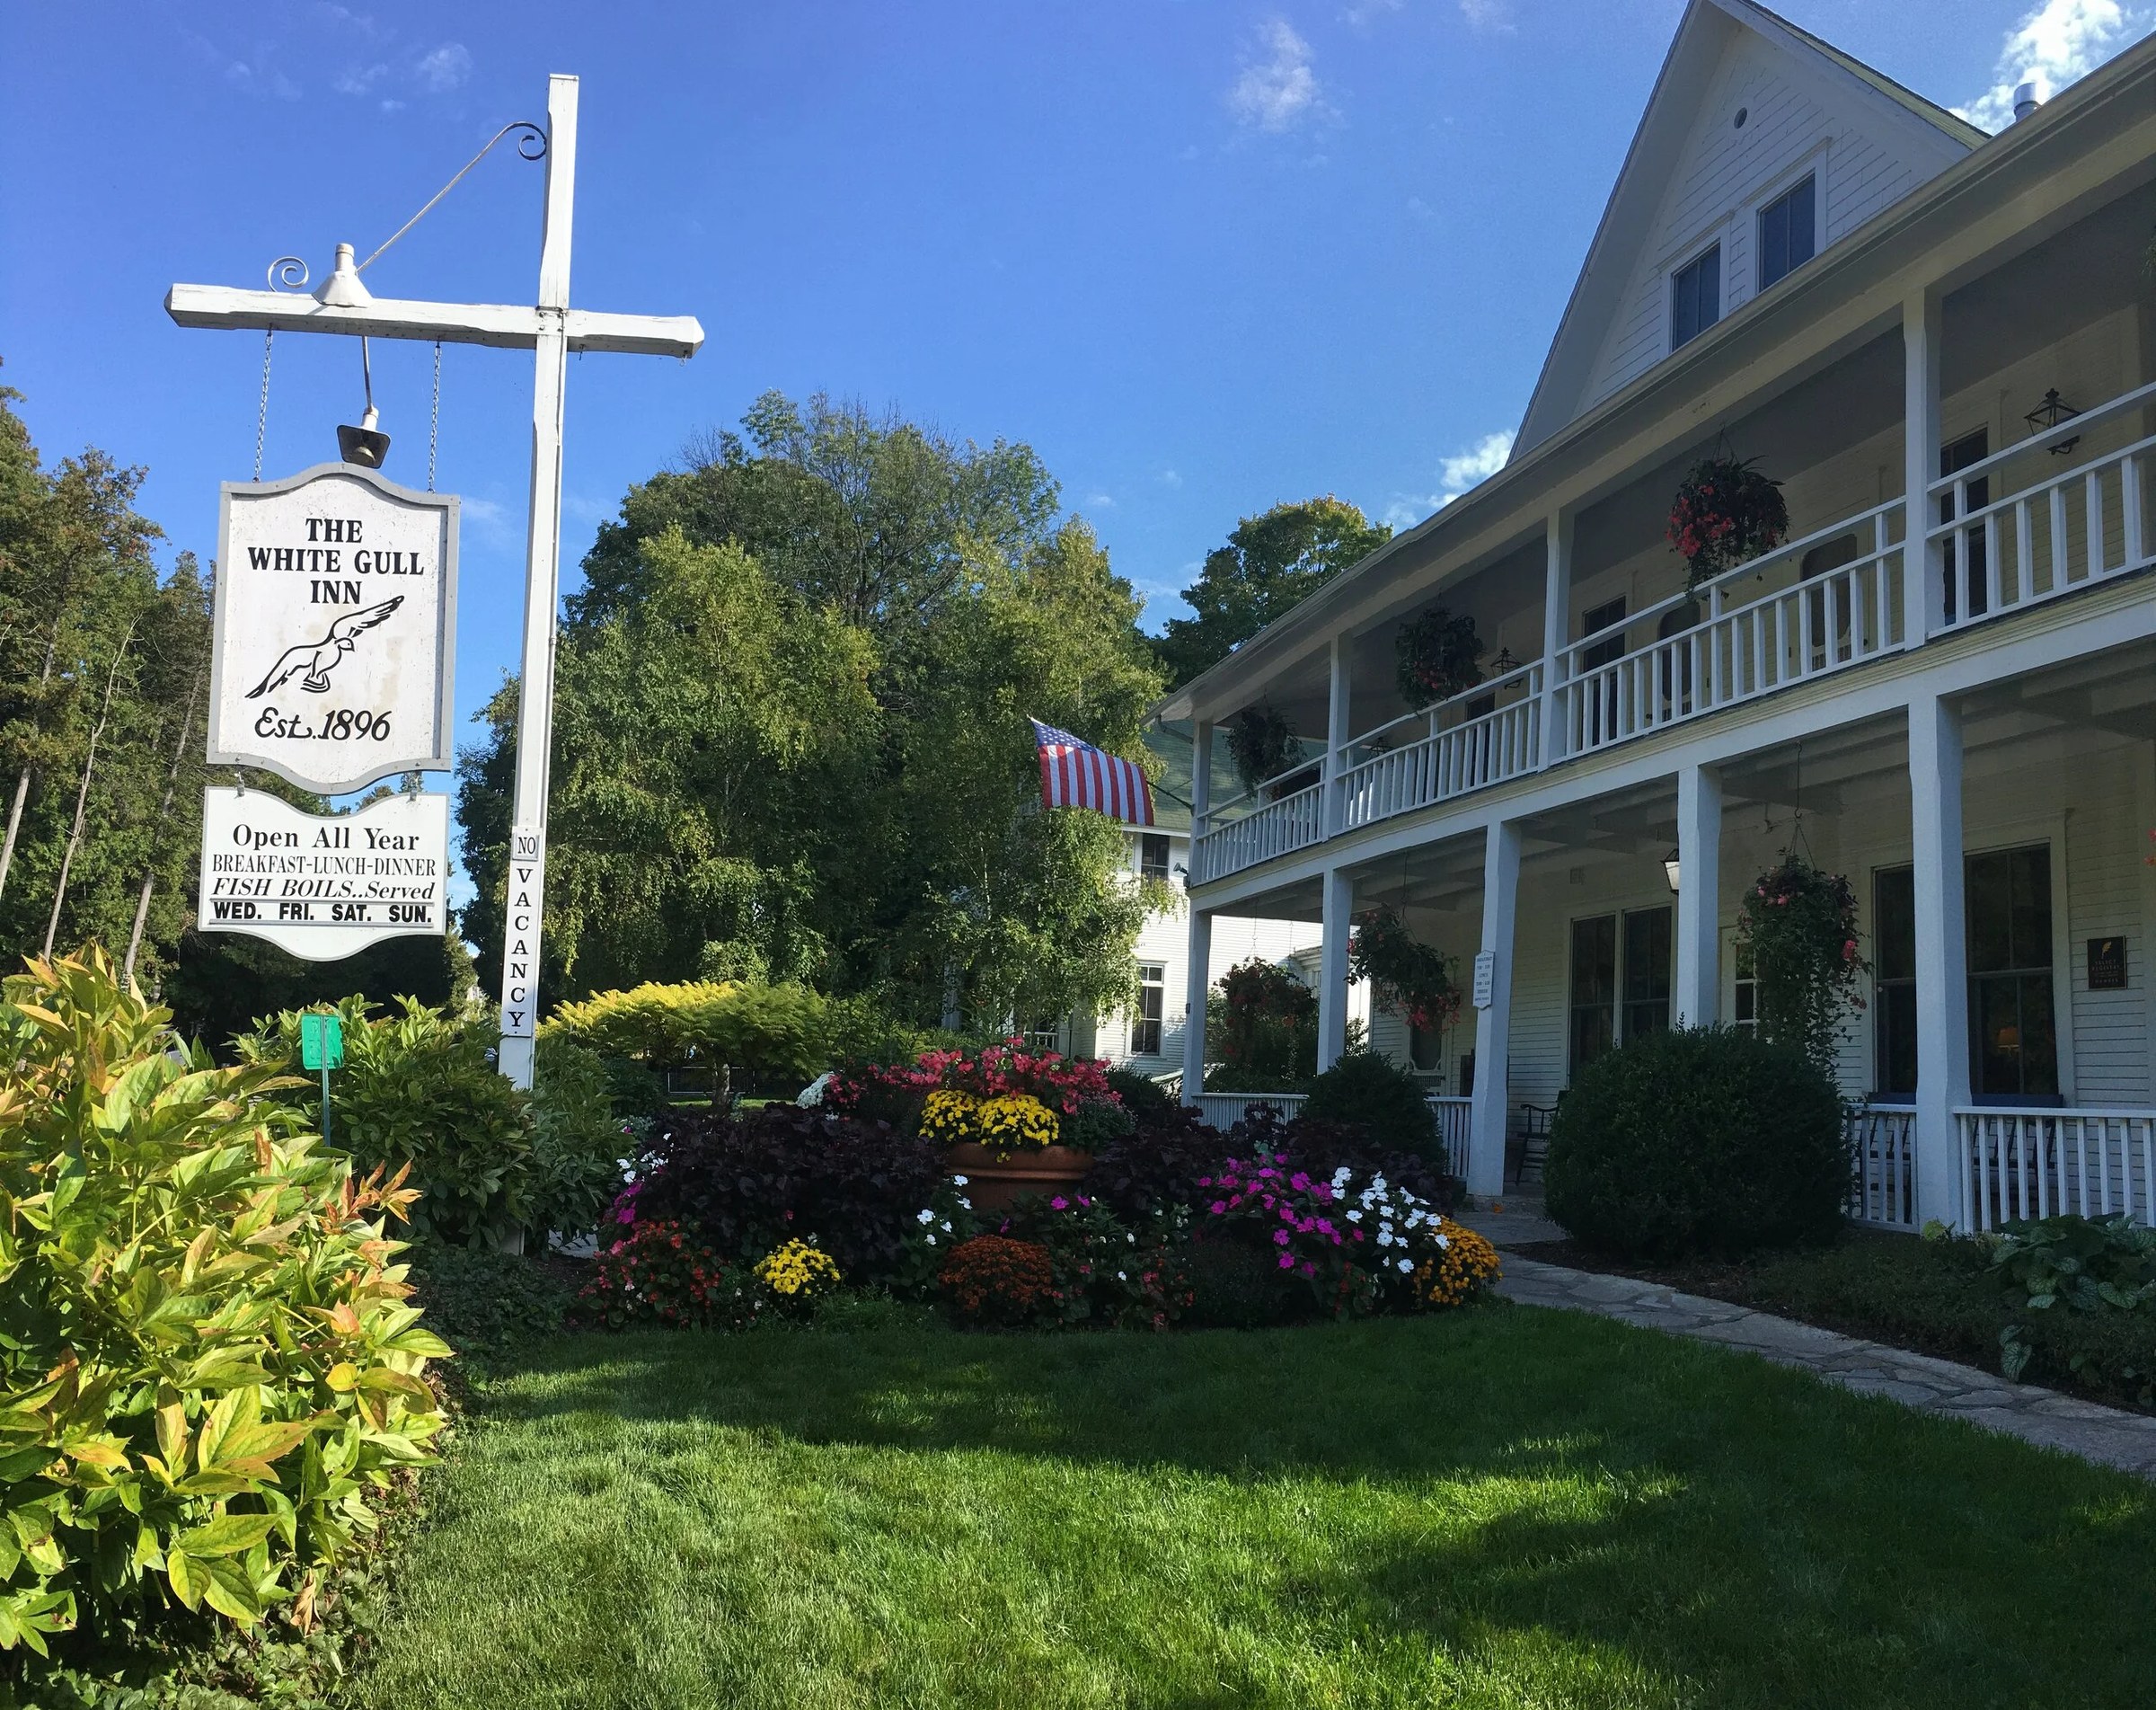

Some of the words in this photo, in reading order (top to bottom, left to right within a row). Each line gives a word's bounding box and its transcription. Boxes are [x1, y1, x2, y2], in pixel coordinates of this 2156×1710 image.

[305, 518, 363, 544] THE
[247, 546, 340, 572] WHITE
[354, 549, 424, 576] GULL
[310, 580, 362, 605] INN
[233, 824, 299, 851] Open
[313, 826, 349, 849] All
[364, 828, 420, 851] Year
[517, 837, 536, 855] NO
[212, 877, 272, 896] FISH
[214, 901, 262, 920] WED.
[278, 902, 314, 921] FRI.
[331, 903, 372, 922] SAT.
[388, 902, 433, 923] SUN.
[508, 868, 534, 1028] VACANCY
